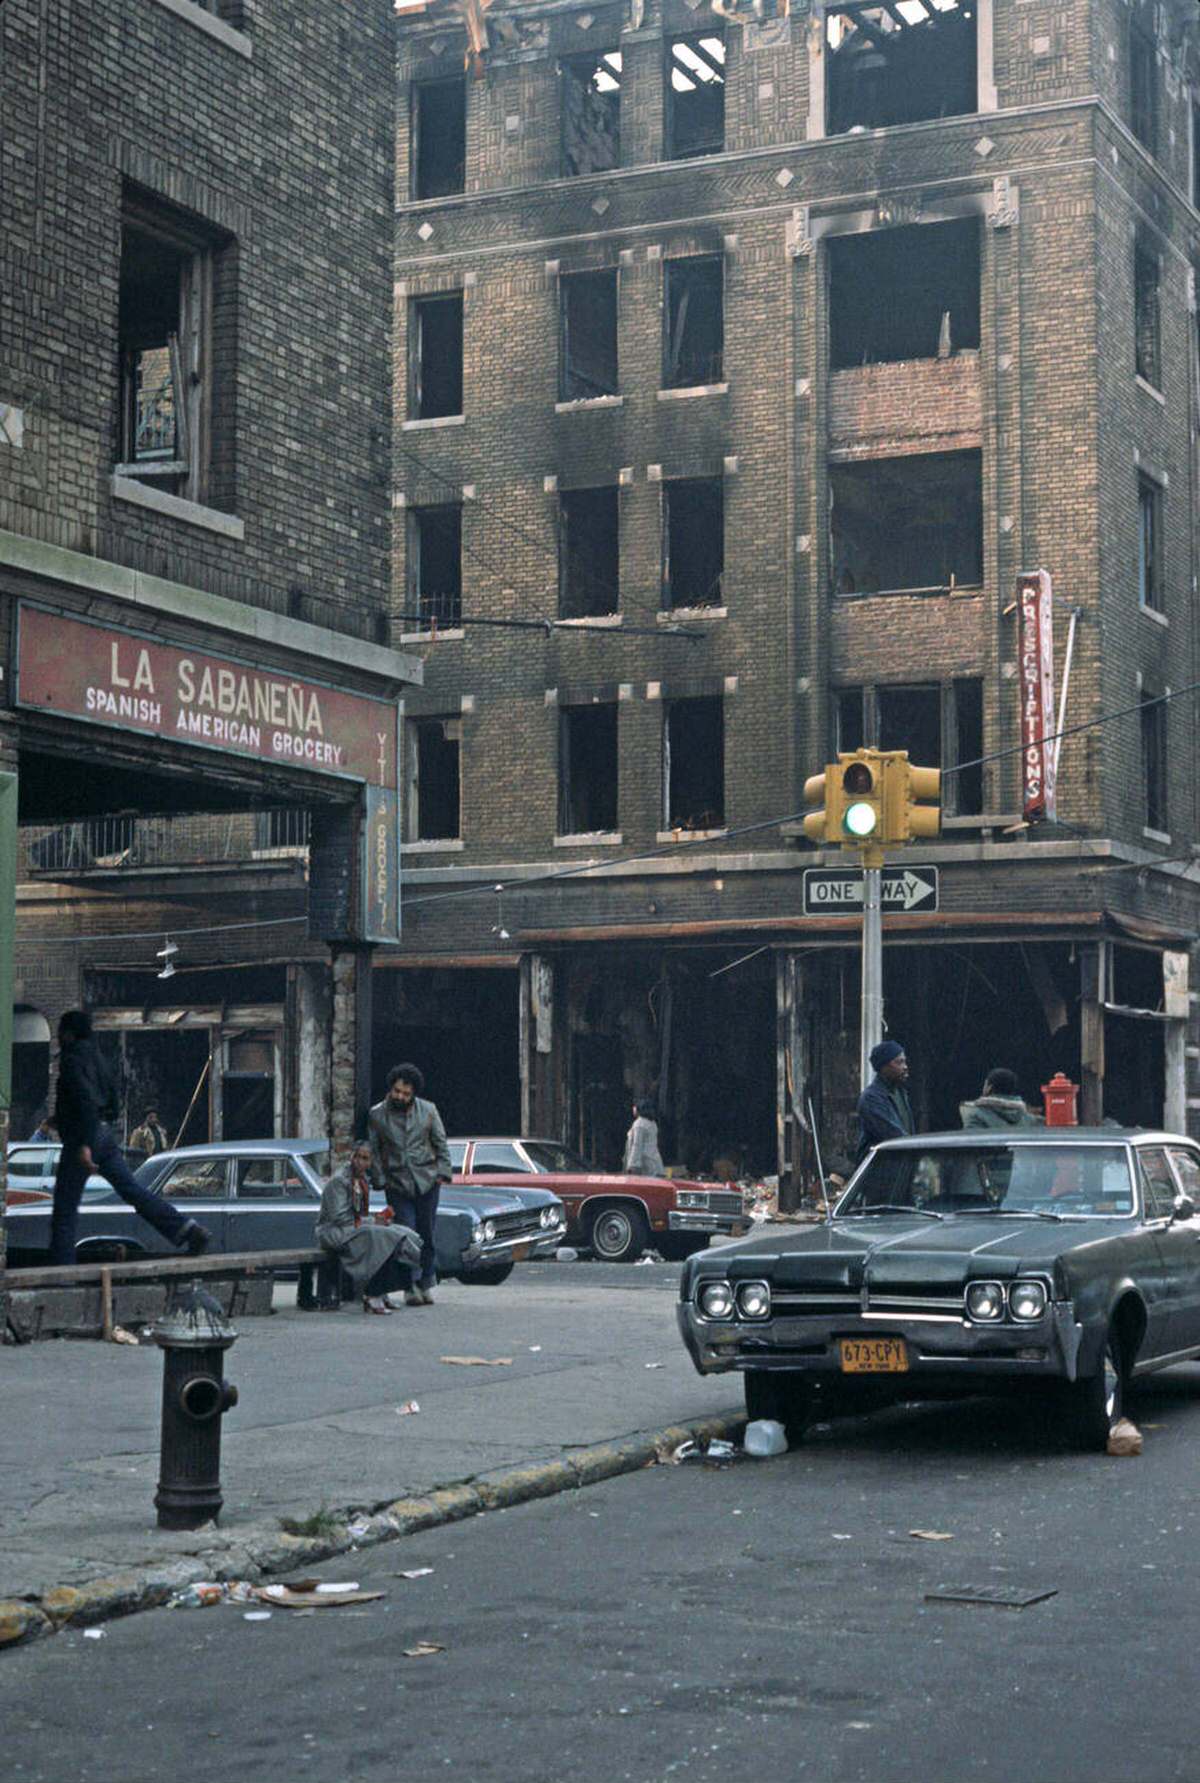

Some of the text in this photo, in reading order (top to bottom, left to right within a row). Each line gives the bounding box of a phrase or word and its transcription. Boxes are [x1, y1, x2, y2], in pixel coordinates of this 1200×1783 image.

[86, 687, 342, 764] SPANISH AMERICAN GROCERY
[111, 642, 324, 735] LA SABANEÑA
[1022, 588, 1040, 799] PRESCRIPTIONS
[816, 881, 918, 900] ONE WAY
